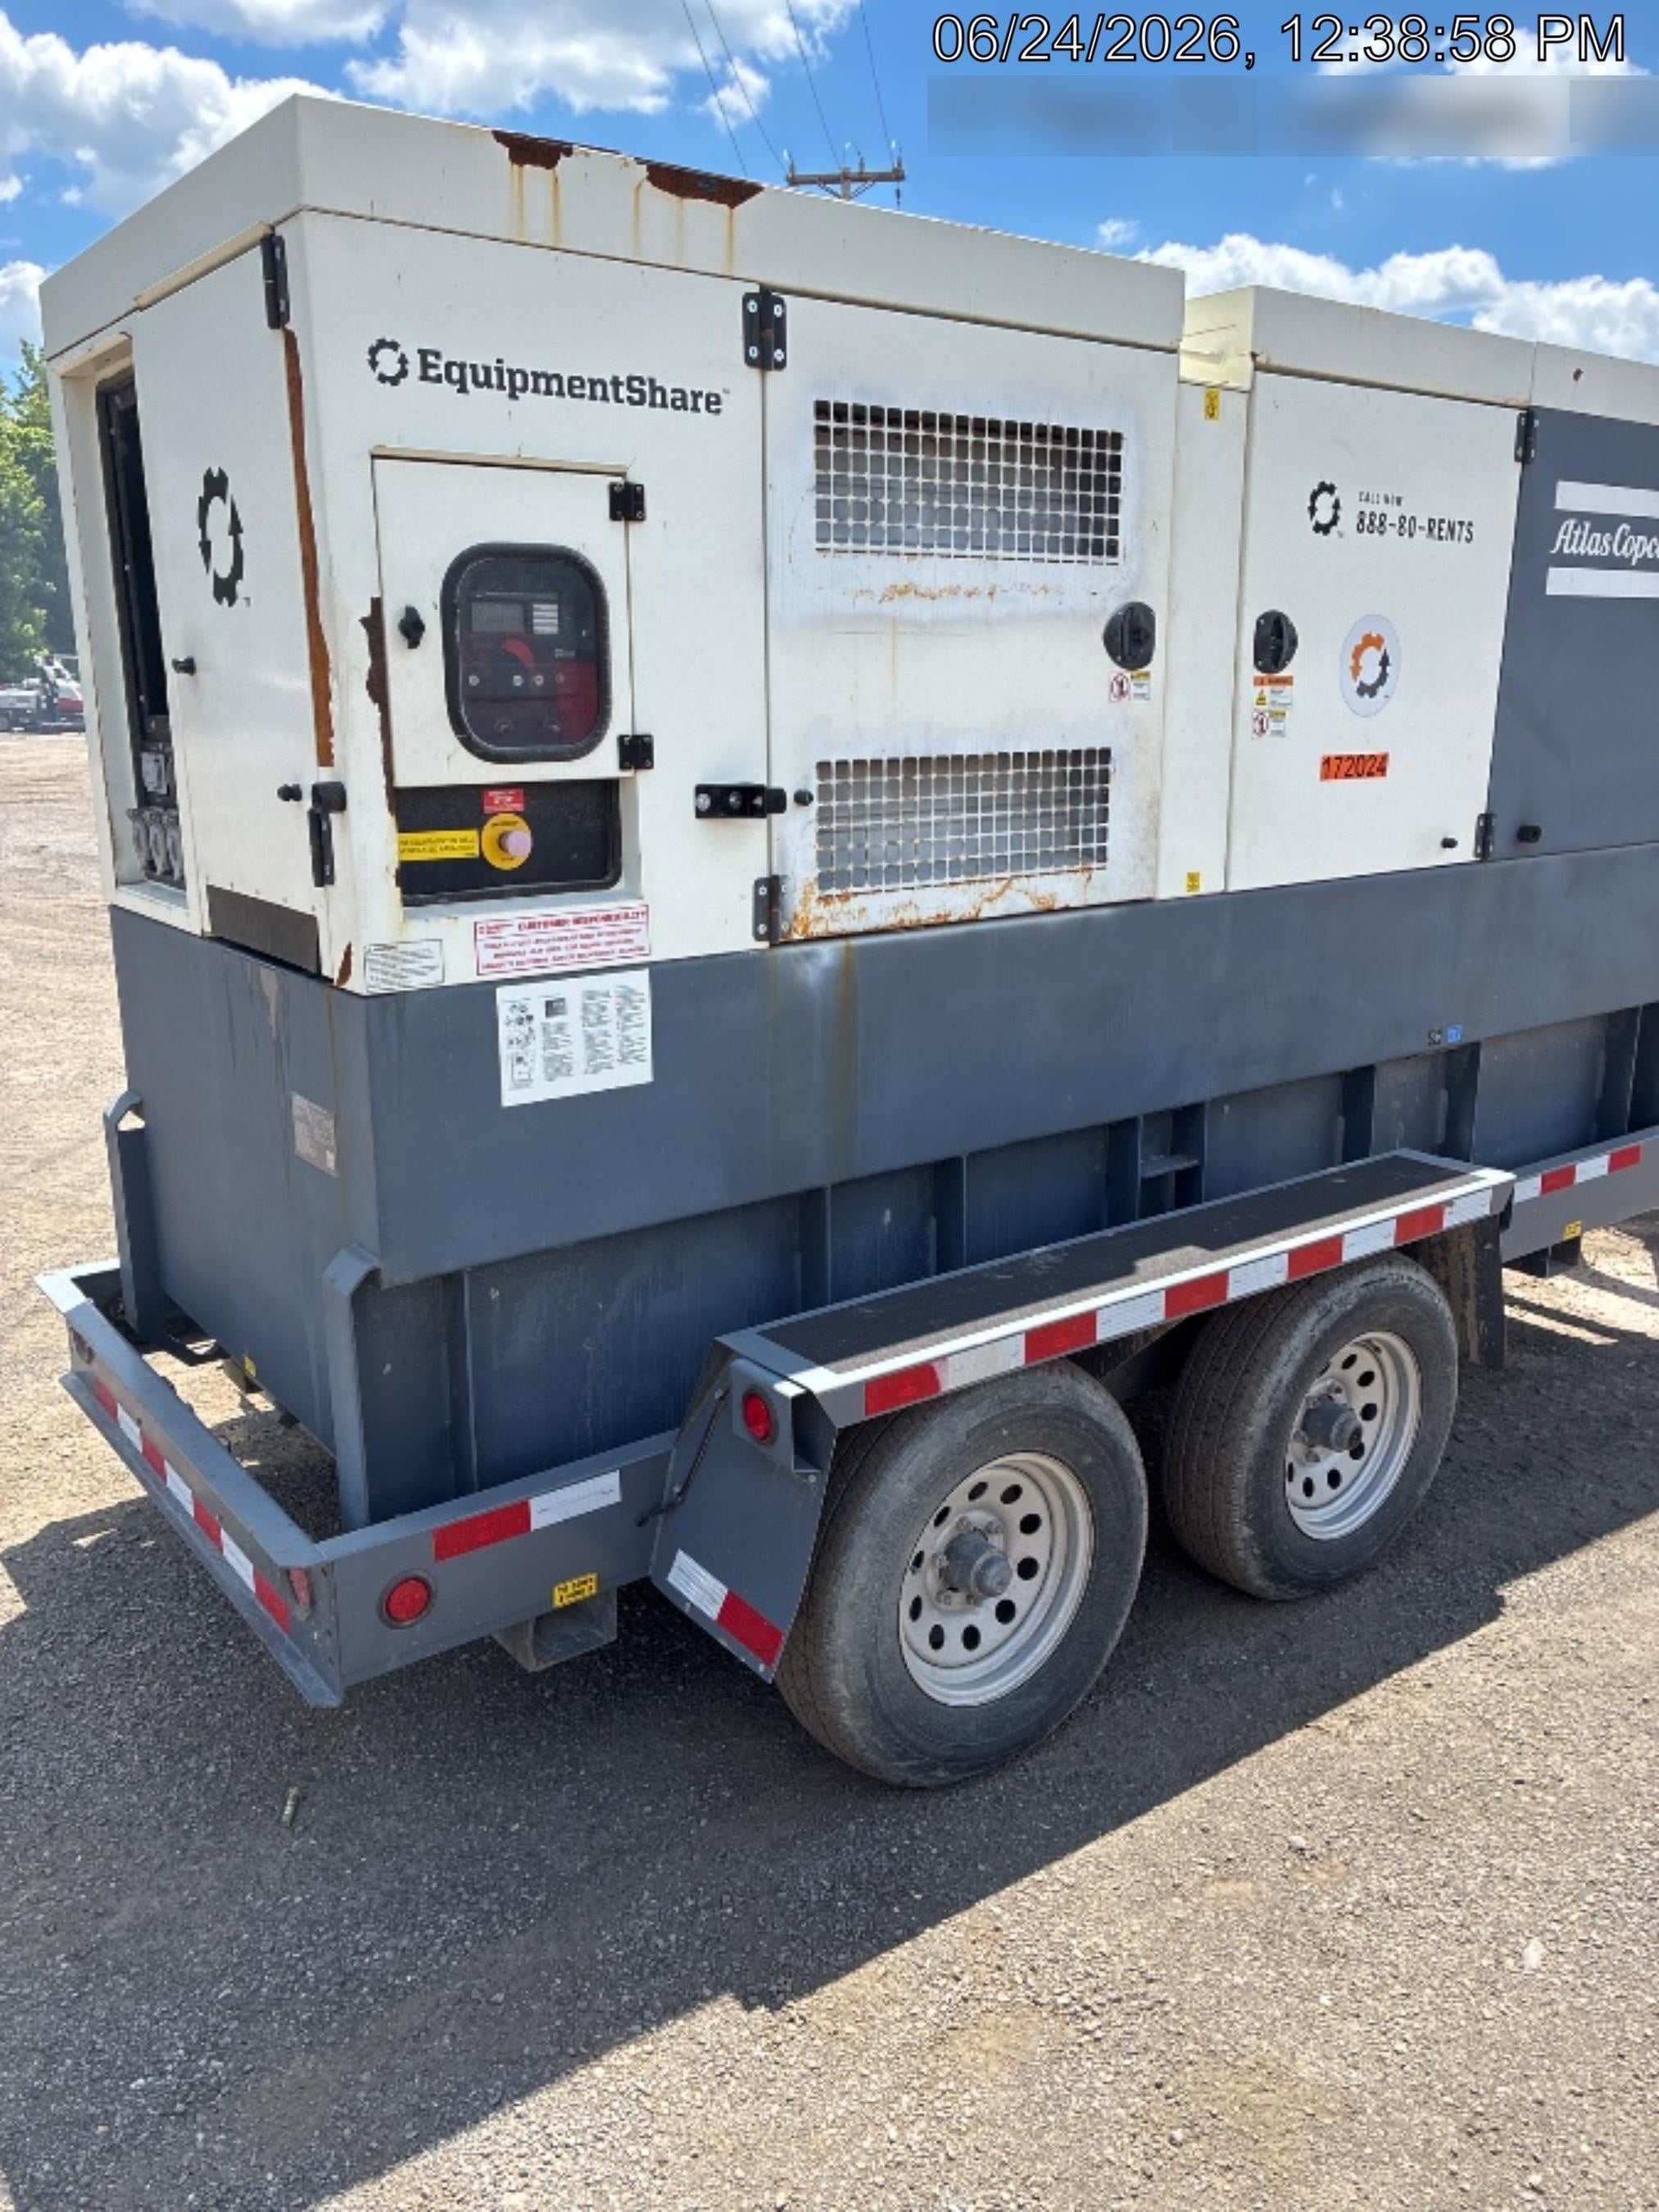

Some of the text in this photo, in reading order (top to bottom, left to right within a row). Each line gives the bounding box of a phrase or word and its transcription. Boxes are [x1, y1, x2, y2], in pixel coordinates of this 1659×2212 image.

[418, 347, 723, 415] EquipmentShare
[1356, 510, 1473, 543] 888-80-RENTS
[1550, 519, 1612, 556] Atlas
[1321, 754, 1388, 780] 172024
